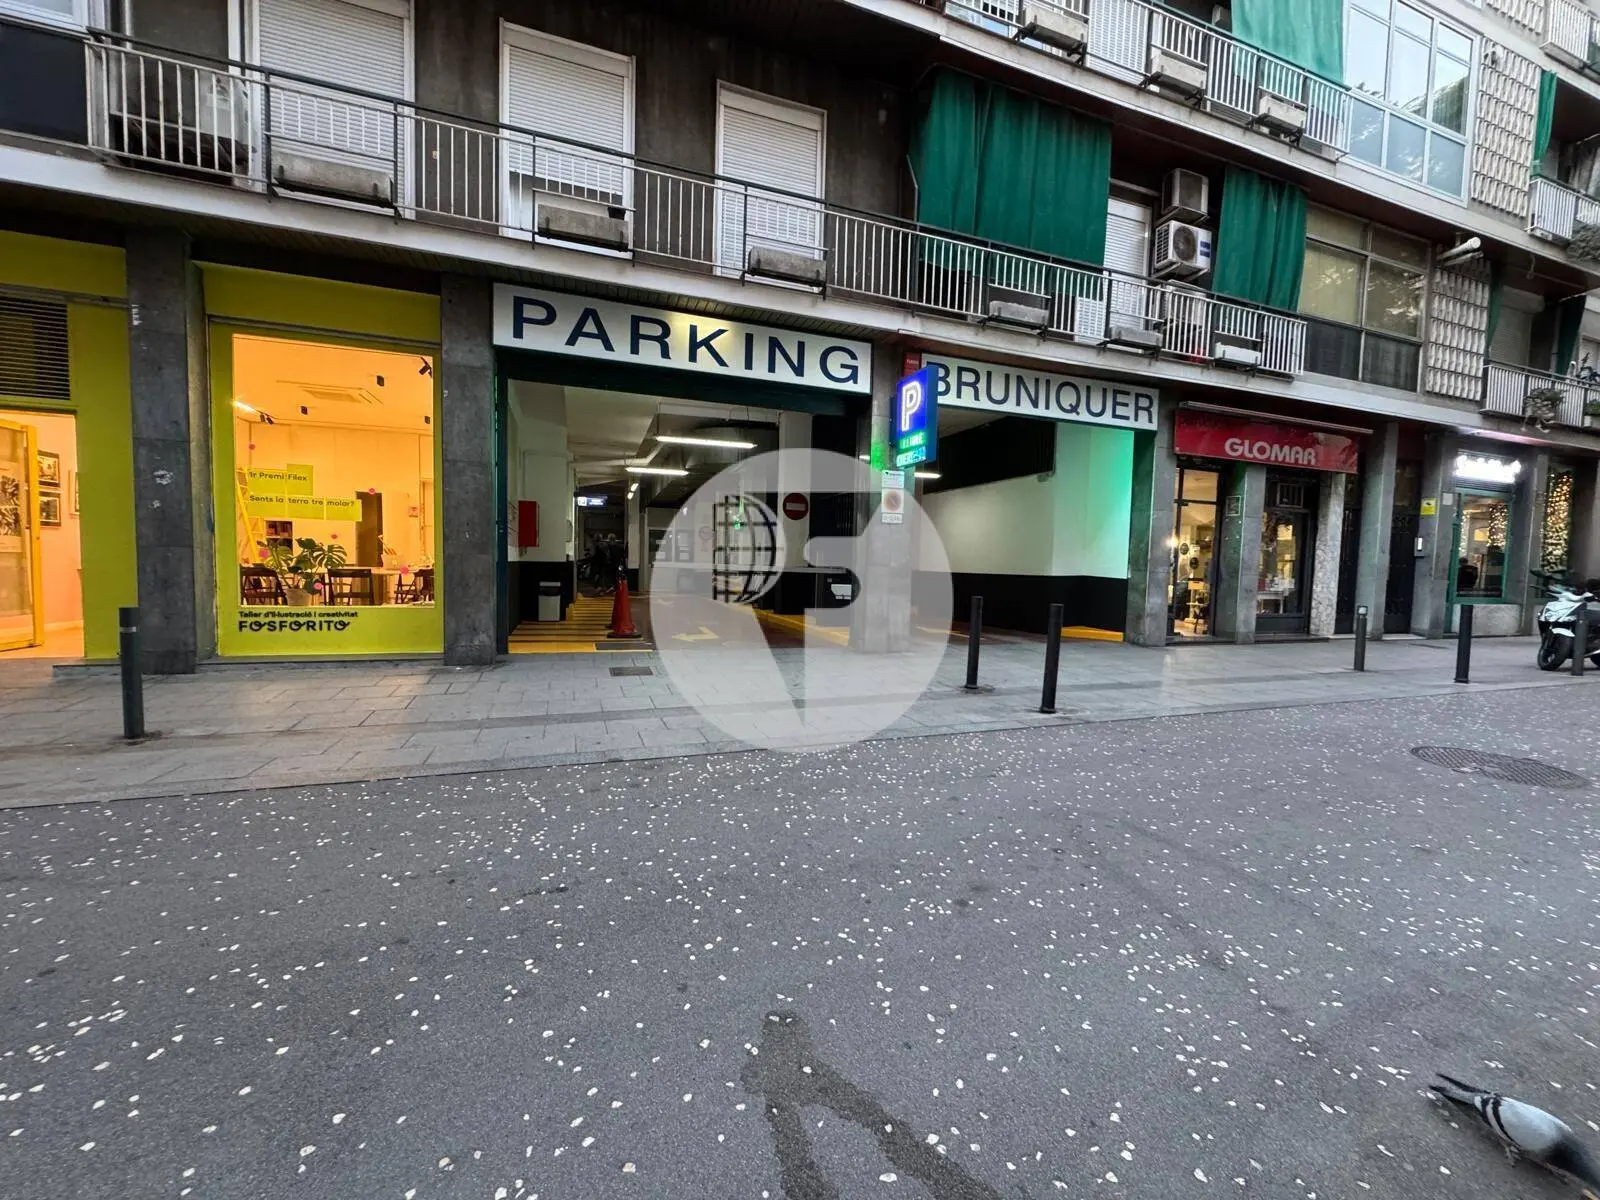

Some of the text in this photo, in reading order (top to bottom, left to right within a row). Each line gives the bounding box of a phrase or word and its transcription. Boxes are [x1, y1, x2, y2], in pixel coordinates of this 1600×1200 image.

[512, 295, 860, 385] PARKING
[902, 381, 921, 432] P
[926, 361, 1154, 425] BRUNIQUER
[1224, 437, 1317, 466] GLOMAR
[260, 472, 285, 480] Premi
[275, 495, 284, 503] la
[239, 620, 350, 632] FOSFORITO
